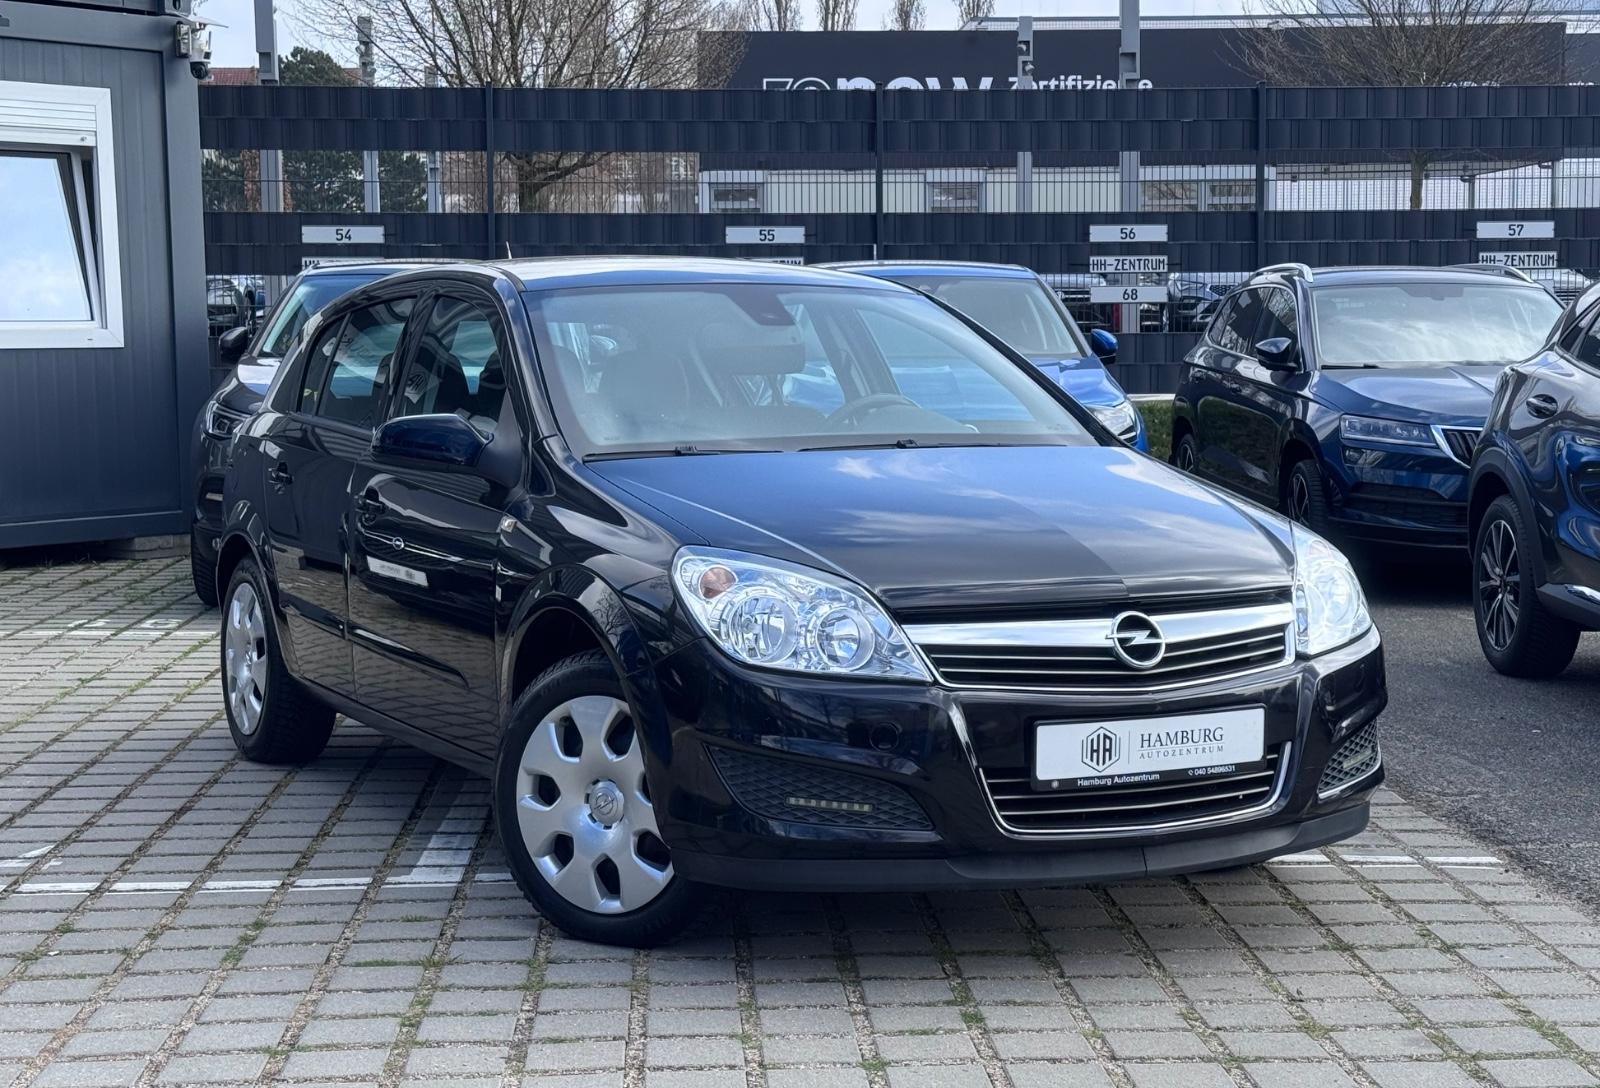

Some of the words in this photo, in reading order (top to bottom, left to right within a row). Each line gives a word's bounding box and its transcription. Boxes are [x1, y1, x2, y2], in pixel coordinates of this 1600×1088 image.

[335, 228, 352, 241] 54
[759, 229, 775, 242] 55
[1120, 227, 1136, 240] 56
[1508, 224, 1524, 236] 57
[1092, 258, 1166, 271] HH-ZENTRUM
[1481, 254, 1555, 267] HH-ZENTRUM
[1122, 288, 1138, 301] 68
[1140, 726, 1224, 749] HAMBURG
[1090, 732, 1113, 767] HA
[1139, 745, 1224, 759] AUTOZENTRUM
[1194, 767, 1206, 776] 040
[1077, 777, 1112, 787] Hamburg
[1113, 773, 1160, 785] Autozentrum
